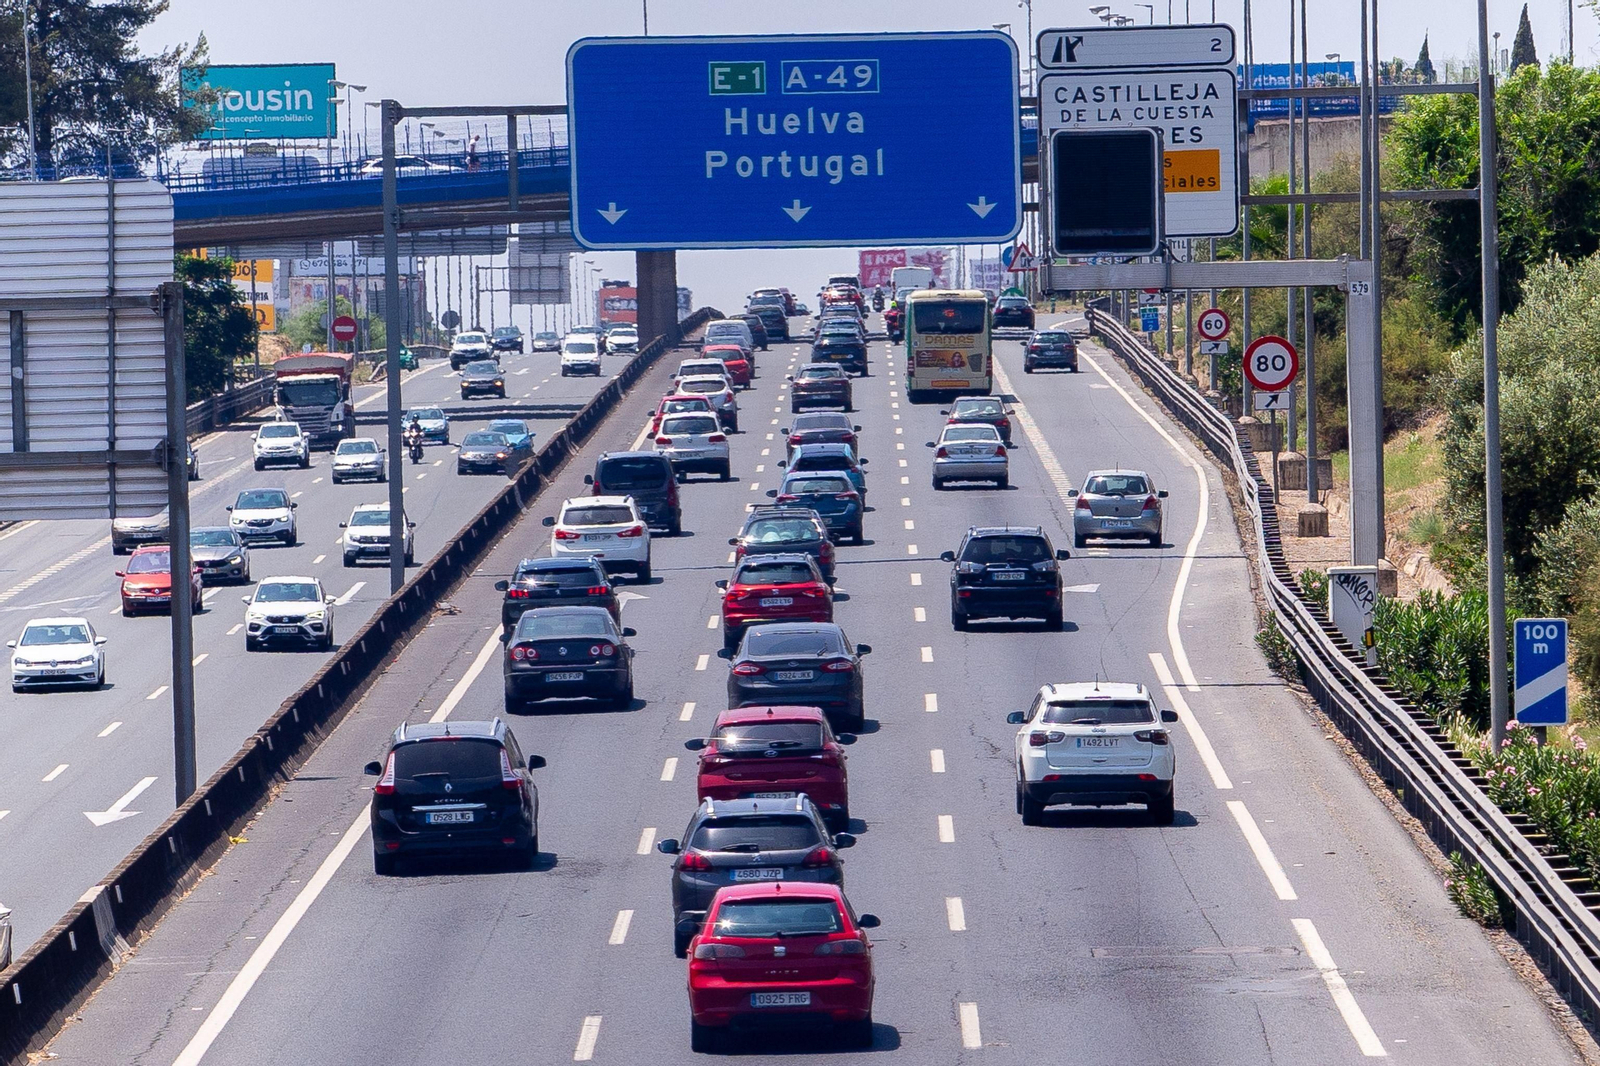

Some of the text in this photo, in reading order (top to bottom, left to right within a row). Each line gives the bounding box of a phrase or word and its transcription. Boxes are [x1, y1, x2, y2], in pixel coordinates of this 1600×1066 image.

[1210, 38, 1223, 53] 2
[713, 65, 872, 90] E-1 A-49
[1054, 83, 1220, 104] CASTILLEJA
[225, 115, 263, 124] concepto
[264, 114, 314, 123] inmobiliario
[1060, 105, 1215, 123] DE LA CUESTA
[724, 106, 865, 136] Huelva
[705, 148, 884, 185] Portugal
[1204, 319, 1223, 331] 60
[925, 335, 975, 344] DAMAS
[1256, 355, 1286, 373] 80
[1523, 624, 1559, 640] 100
[1533, 642, 1549, 654] m
[1082, 738, 1119, 748] 1492 LVT
[433, 812, 453, 823] 0528
[737, 868, 781, 879] 4680 JZP
[758, 993, 808, 1005] 0925 FRG
